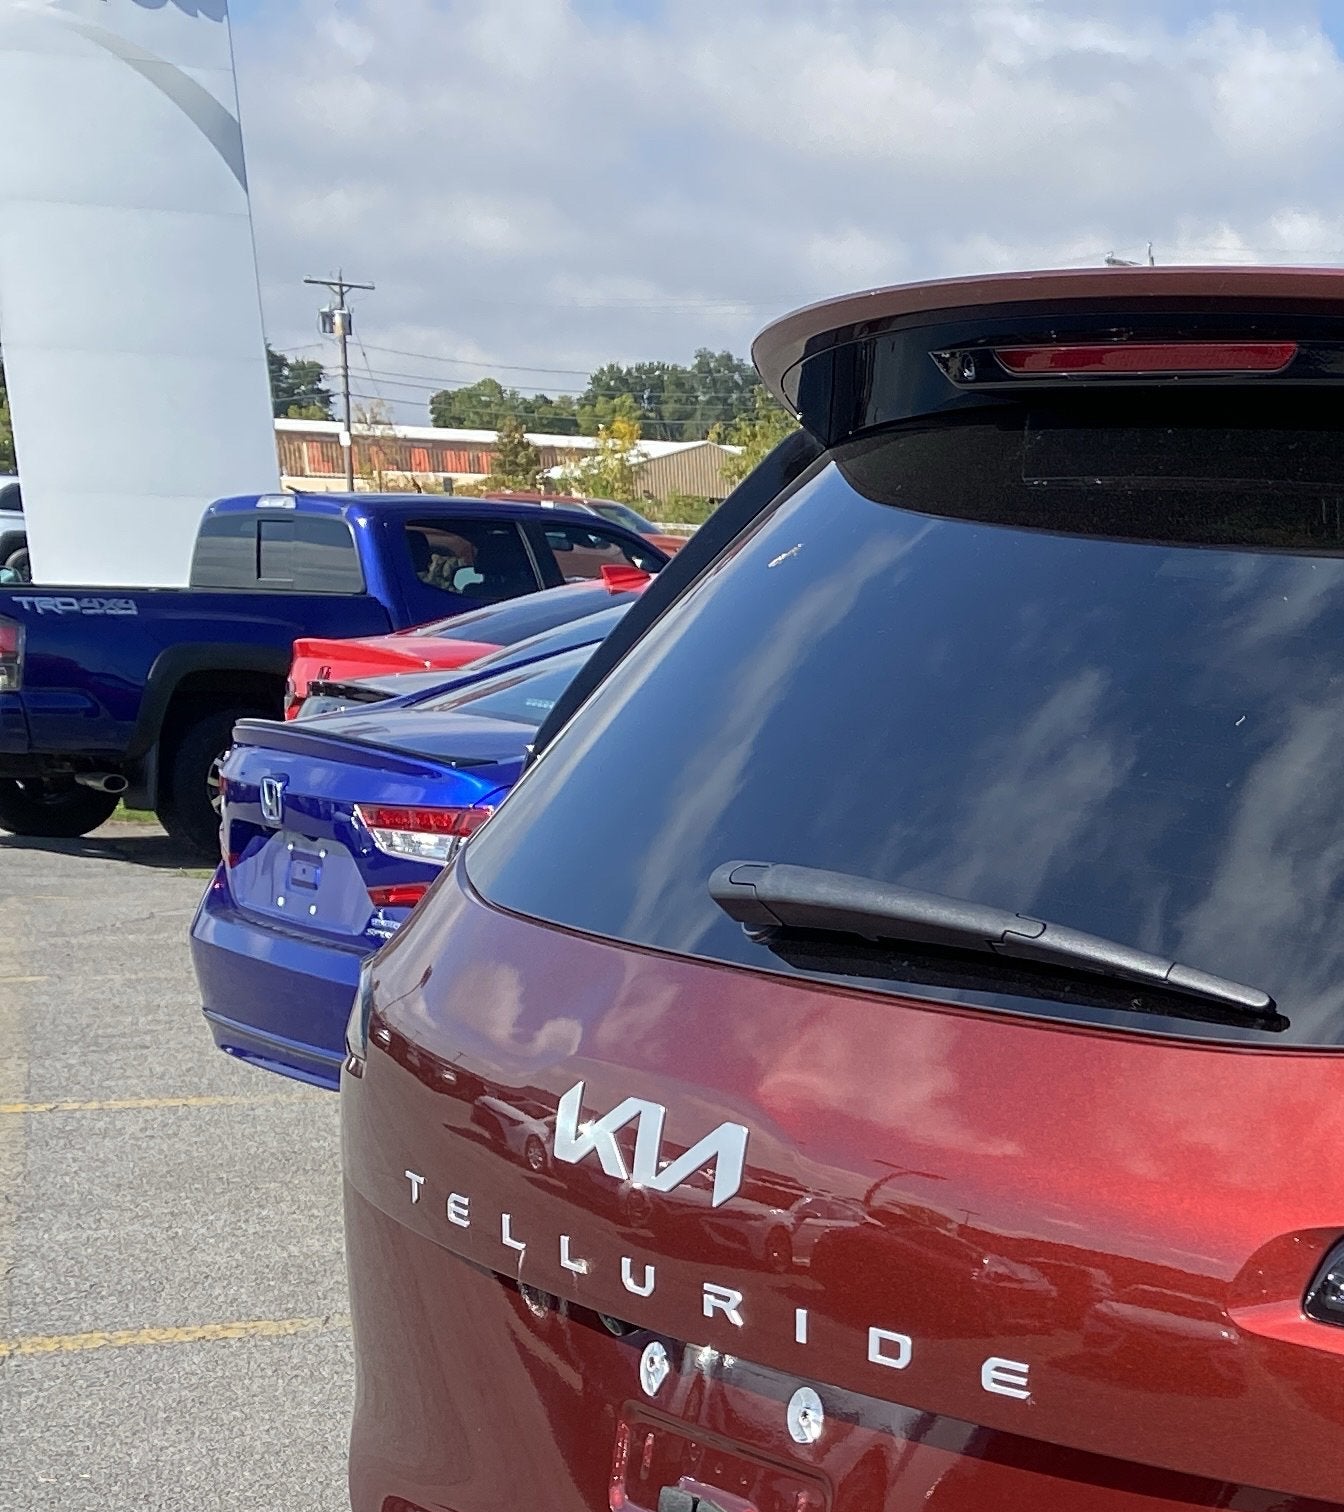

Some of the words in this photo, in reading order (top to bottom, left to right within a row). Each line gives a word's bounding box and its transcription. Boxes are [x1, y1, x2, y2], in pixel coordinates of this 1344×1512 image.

[11, 596, 80, 615] TRD
[553, 1080, 749, 1208] KIA
[404, 1169, 1032, 1401] TELLURIDE
